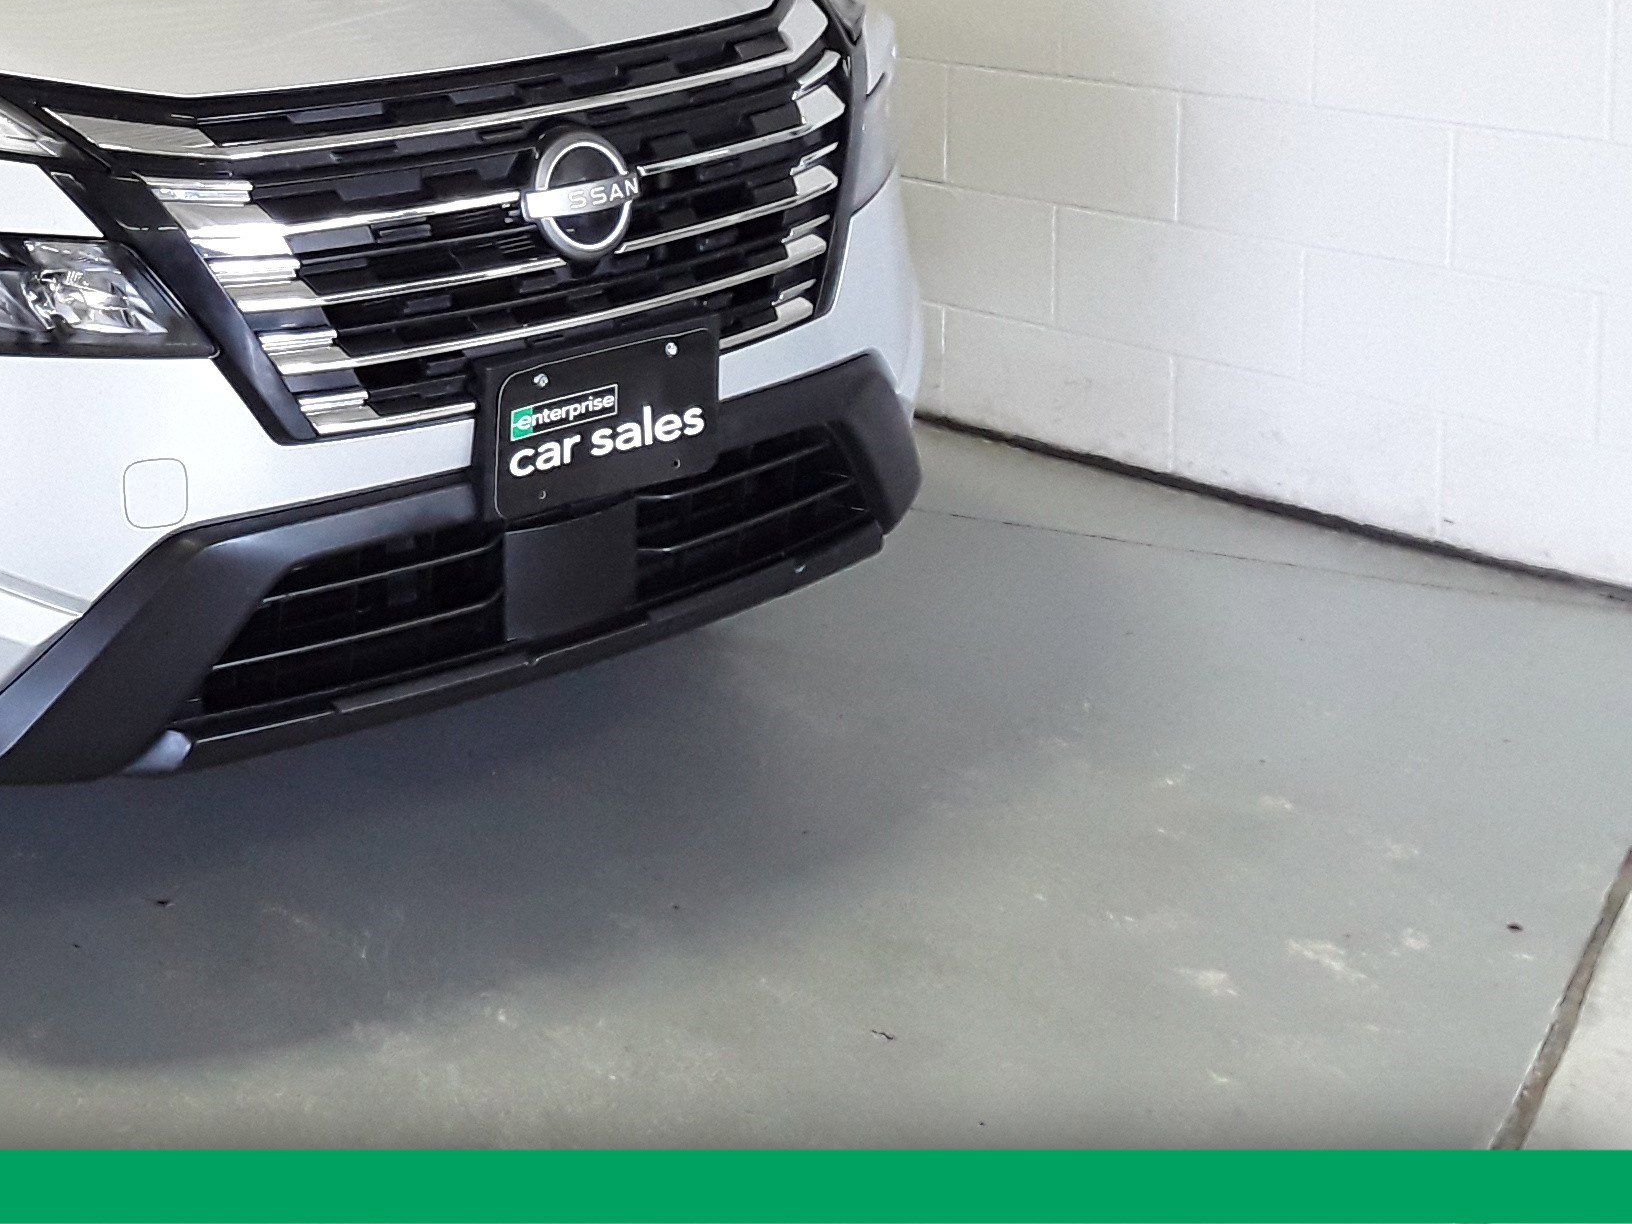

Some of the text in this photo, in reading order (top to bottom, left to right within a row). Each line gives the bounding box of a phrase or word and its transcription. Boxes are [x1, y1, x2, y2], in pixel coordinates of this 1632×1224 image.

[534, 178, 640, 214] SSAN
[512, 393, 615, 430] enterprise
[509, 405, 706, 478] car sales
